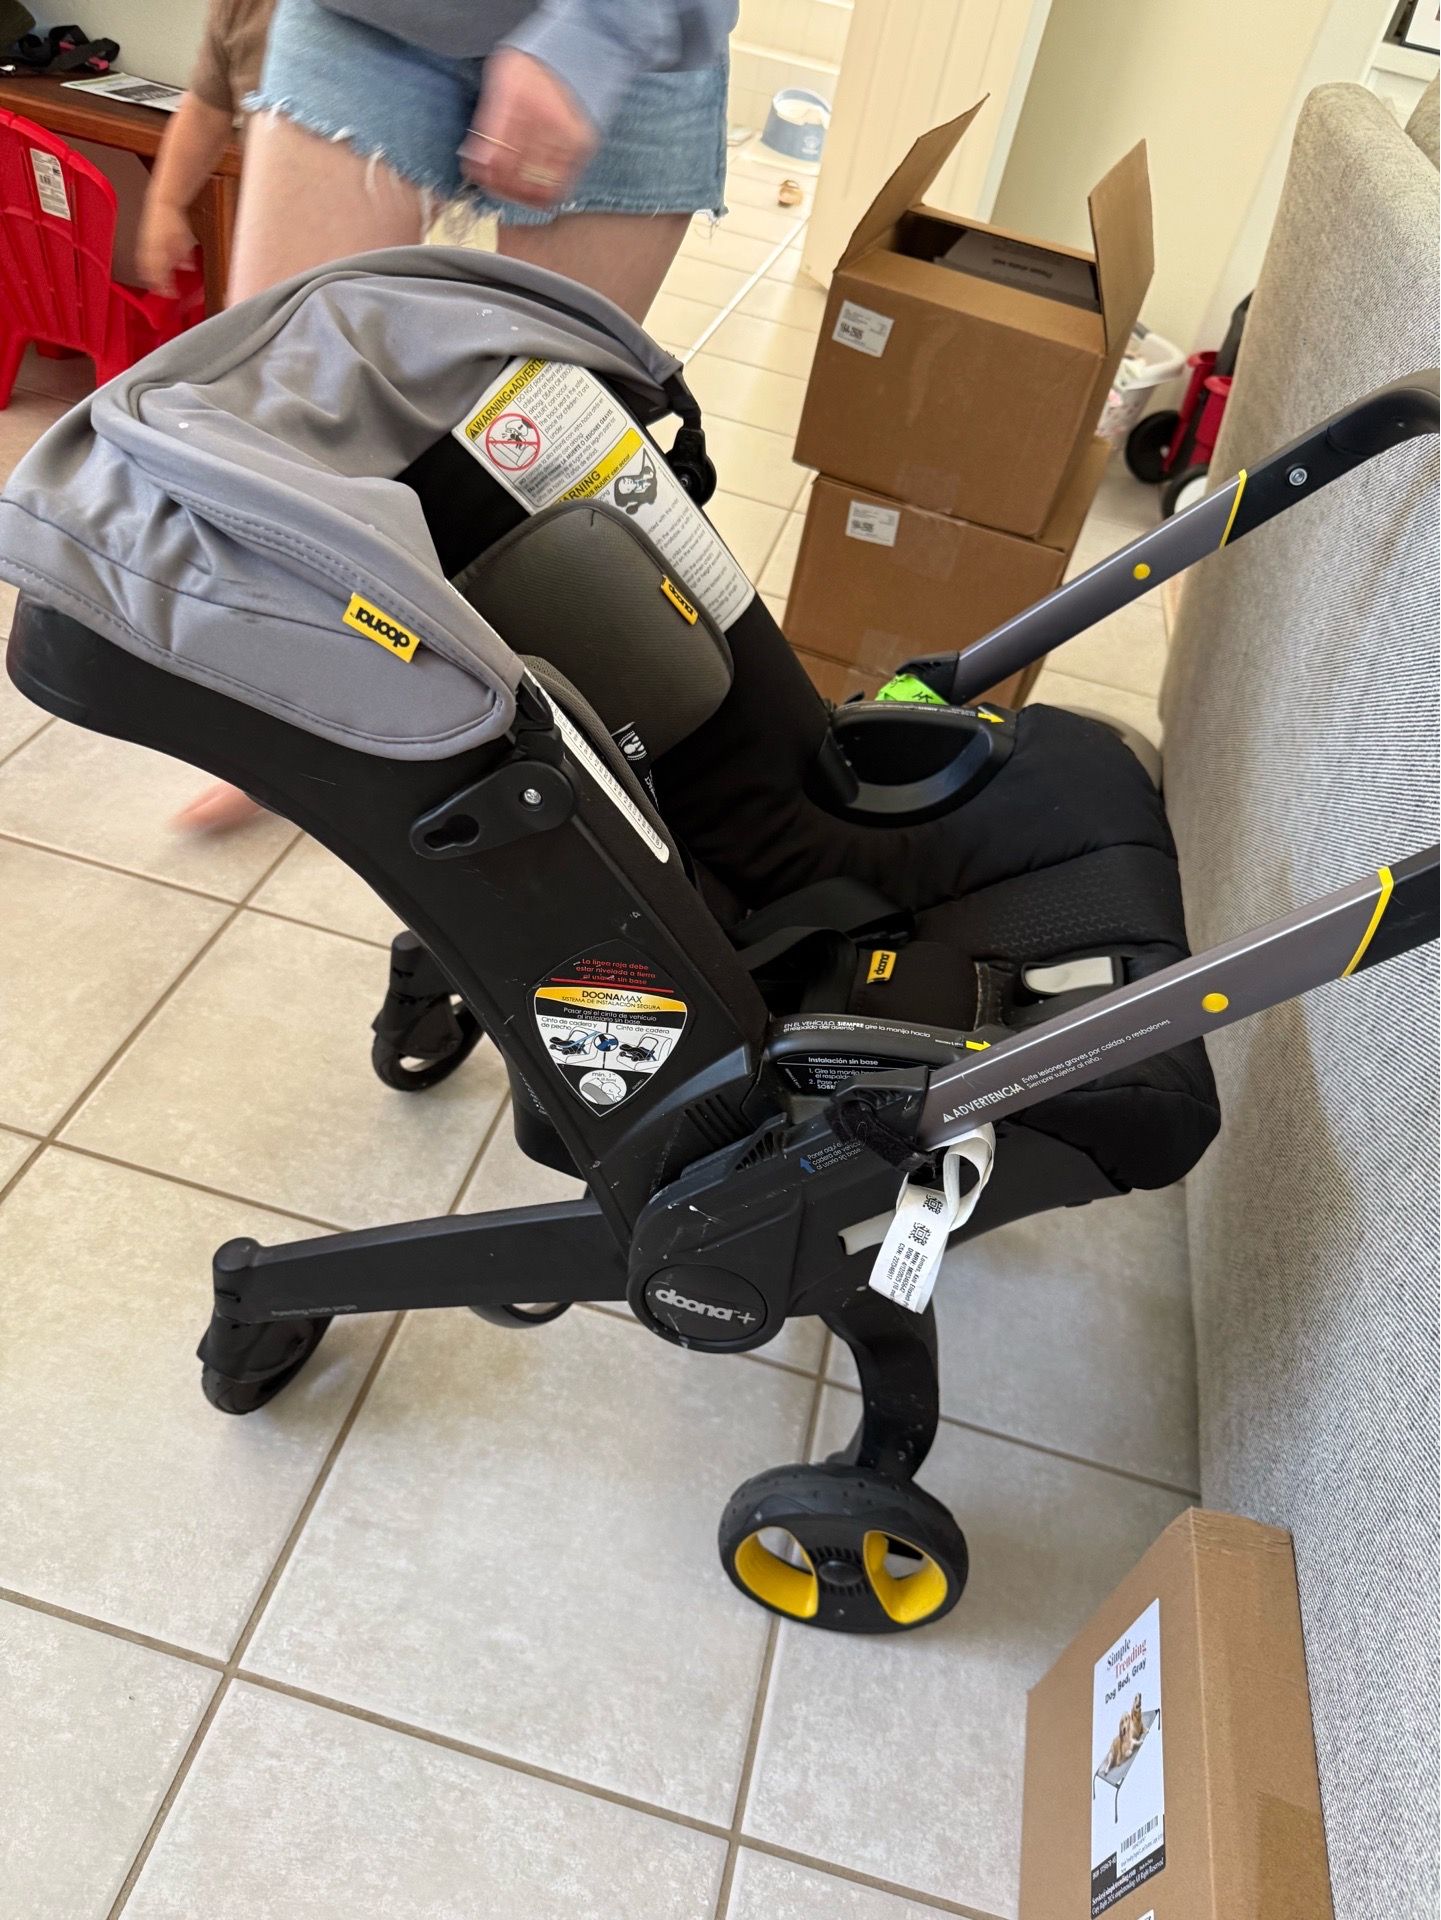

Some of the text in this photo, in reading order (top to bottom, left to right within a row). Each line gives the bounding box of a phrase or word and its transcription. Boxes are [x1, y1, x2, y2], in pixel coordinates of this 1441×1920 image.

[473, 355, 544, 430] WARNING ADVERTE
[542, 385, 556, 399] DEATH
[547, 396, 557, 406] can
[544, 418, 558, 433] place
[561, 395, 579, 413] children
[580, 383, 589, 392] and
[546, 405, 558, 418] back
[556, 396, 567, 407] seat
[563, 469, 601, 505] ARNING
[666, 583, 694, 614] doona
[353, 606, 411, 652] doona
[595, 967, 628, 976] nivelada
[613, 962, 627, 970] roja
[629, 962, 648, 970] debe
[873, 953, 889, 975] doona
[582, 991, 643, 1003] DOONAMAX
[597, 999, 636, 1008] INSTALACIÓN
[541, 1016, 556, 1024] Cinto
[837, 1021, 864, 1029] SIEMPRE
[910, 1030, 931, 1038] hacia
[1021, 1072, 1038, 1084] Evite
[1037, 1062, 1064, 1076] lesiones
[1064, 1053, 1088, 1066] graves
[1087, 1047, 1101, 1057] por
[1027, 1075, 1053, 1088] Siempre
[1053, 1065, 1076, 1078] sujetar
[1083, 1054, 1102, 1065] niño.
[952, 1083, 1025, 1116] ADVERTENCIA
[807, 1149, 823, 1160] Poner
[811, 1152, 833, 1165] cadera
[895, 1242, 905, 1255] CSN:
[903, 1247, 913, 1260] DOB:
[909, 1251, 920, 1266] MRN:
[1107, 1638, 1131, 1670] Simple
[1114, 1639, 1147, 1679] Trending
[1105, 1657, 1146, 1704] Dog Bed, Gray
